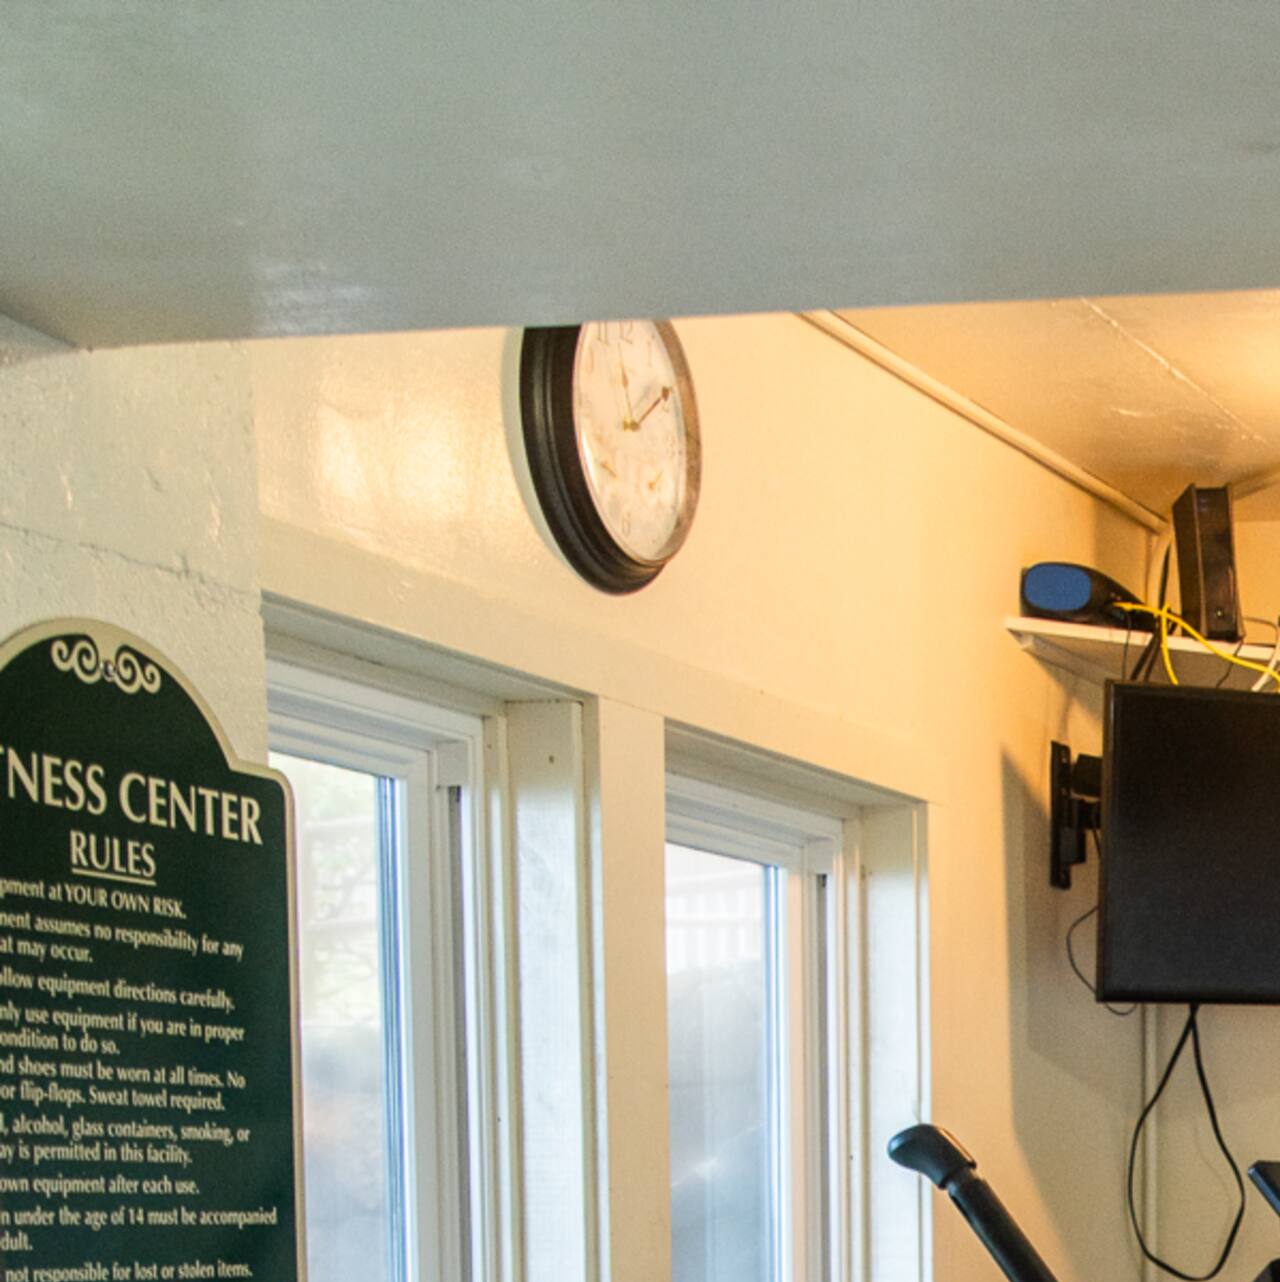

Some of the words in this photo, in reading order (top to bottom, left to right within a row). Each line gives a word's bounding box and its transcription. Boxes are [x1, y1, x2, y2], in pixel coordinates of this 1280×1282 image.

[0, 743, 107, 815] NESS
[119, 771, 263, 845] CENTER
[70, 829, 157, 878] RULES
[48, 883, 62, 901] at
[64, 883, 108, 908] YOUR
[111, 890, 150, 913] OWN
[153, 896, 187, 919] RISK.
[17, 940, 47, 963] may
[50, 944, 93, 963] occur.
[34, 917, 91, 938] assumes
[94, 924, 112, 940] no
[115, 927, 199, 957] responsibility
[202, 932, 219, 954] for
[222, 941, 244, 962] any
[38, 970, 110, 999] equipment
[113, 978, 177, 1004] directions
[180, 988, 236, 1015] carefully.
[25, 1007, 49, 1024] use
[52, 1006, 125, 1033] equipment
[127, 1011, 138, 1031] if
[140, 1018, 164, 1038] you
[167, 1020, 187, 1036] are
[190, 1017, 202, 1037] in
[205, 1024, 245, 1045] proper
[62, 1032, 77, 1052] to
[80, 1032, 98, 1053] do
[101, 1038, 120, 1055] so.
[18, 1054, 57, 1077] shoes
[60, 1061, 93, 1079] must
[97, 1059, 114, 1080] be
[116, 1066, 150, 1083] worn
[153, 1067, 166, 1085] at
[169, 1064, 185, 1085] all
[187, 1065, 224, 1088] times.
[226, 1069, 246, 1090] No
[0, 1084, 16, 1100] or
[20, 1080, 86, 1109] flip-flops.
[89, 1085, 129, 1107] Sweat
[131, 1088, 168, 1108] towel
[170, 1090, 226, 1115] required.
[12, 1112, 69, 1138] alcohol,
[72, 1115, 105, 1142] glass
[107, 1118, 178, 1142] containers,
[181, 1120, 234, 1148] smoking,
[237, 1127, 251, 1143] or
[19, 1138, 30, 1159] is
[33, 1140, 101, 1166] permitted
[104, 1142, 117, 1161] in
[120, 1142, 144, 1163] this
[147, 1143, 193, 1169] facility.
[33, 1172, 106, 1199] equipment
[109, 1174, 139, 1194] after
[142, 1175, 172, 1194] each
[174, 1180, 200, 1195] use.
[14, 1205, 55, 1226] under
[59, 1204, 81, 1226] the
[84, 1211, 108, 1232] age
[111, 1205, 126, 1226] of
[128, 1207, 144, 1225] 14
[147, 1208, 178, 1225] must
[181, 1205, 198, 1226] be
[200, 1206, 277, 1231] accompanied
[112, 1261, 132, 1281] for
[134, 1261, 158, 1280] lost
[161, 1265, 175, 1279] or
[178, 1260, 215, 1279] stolen
[217, 1258, 253, 1278] items.
